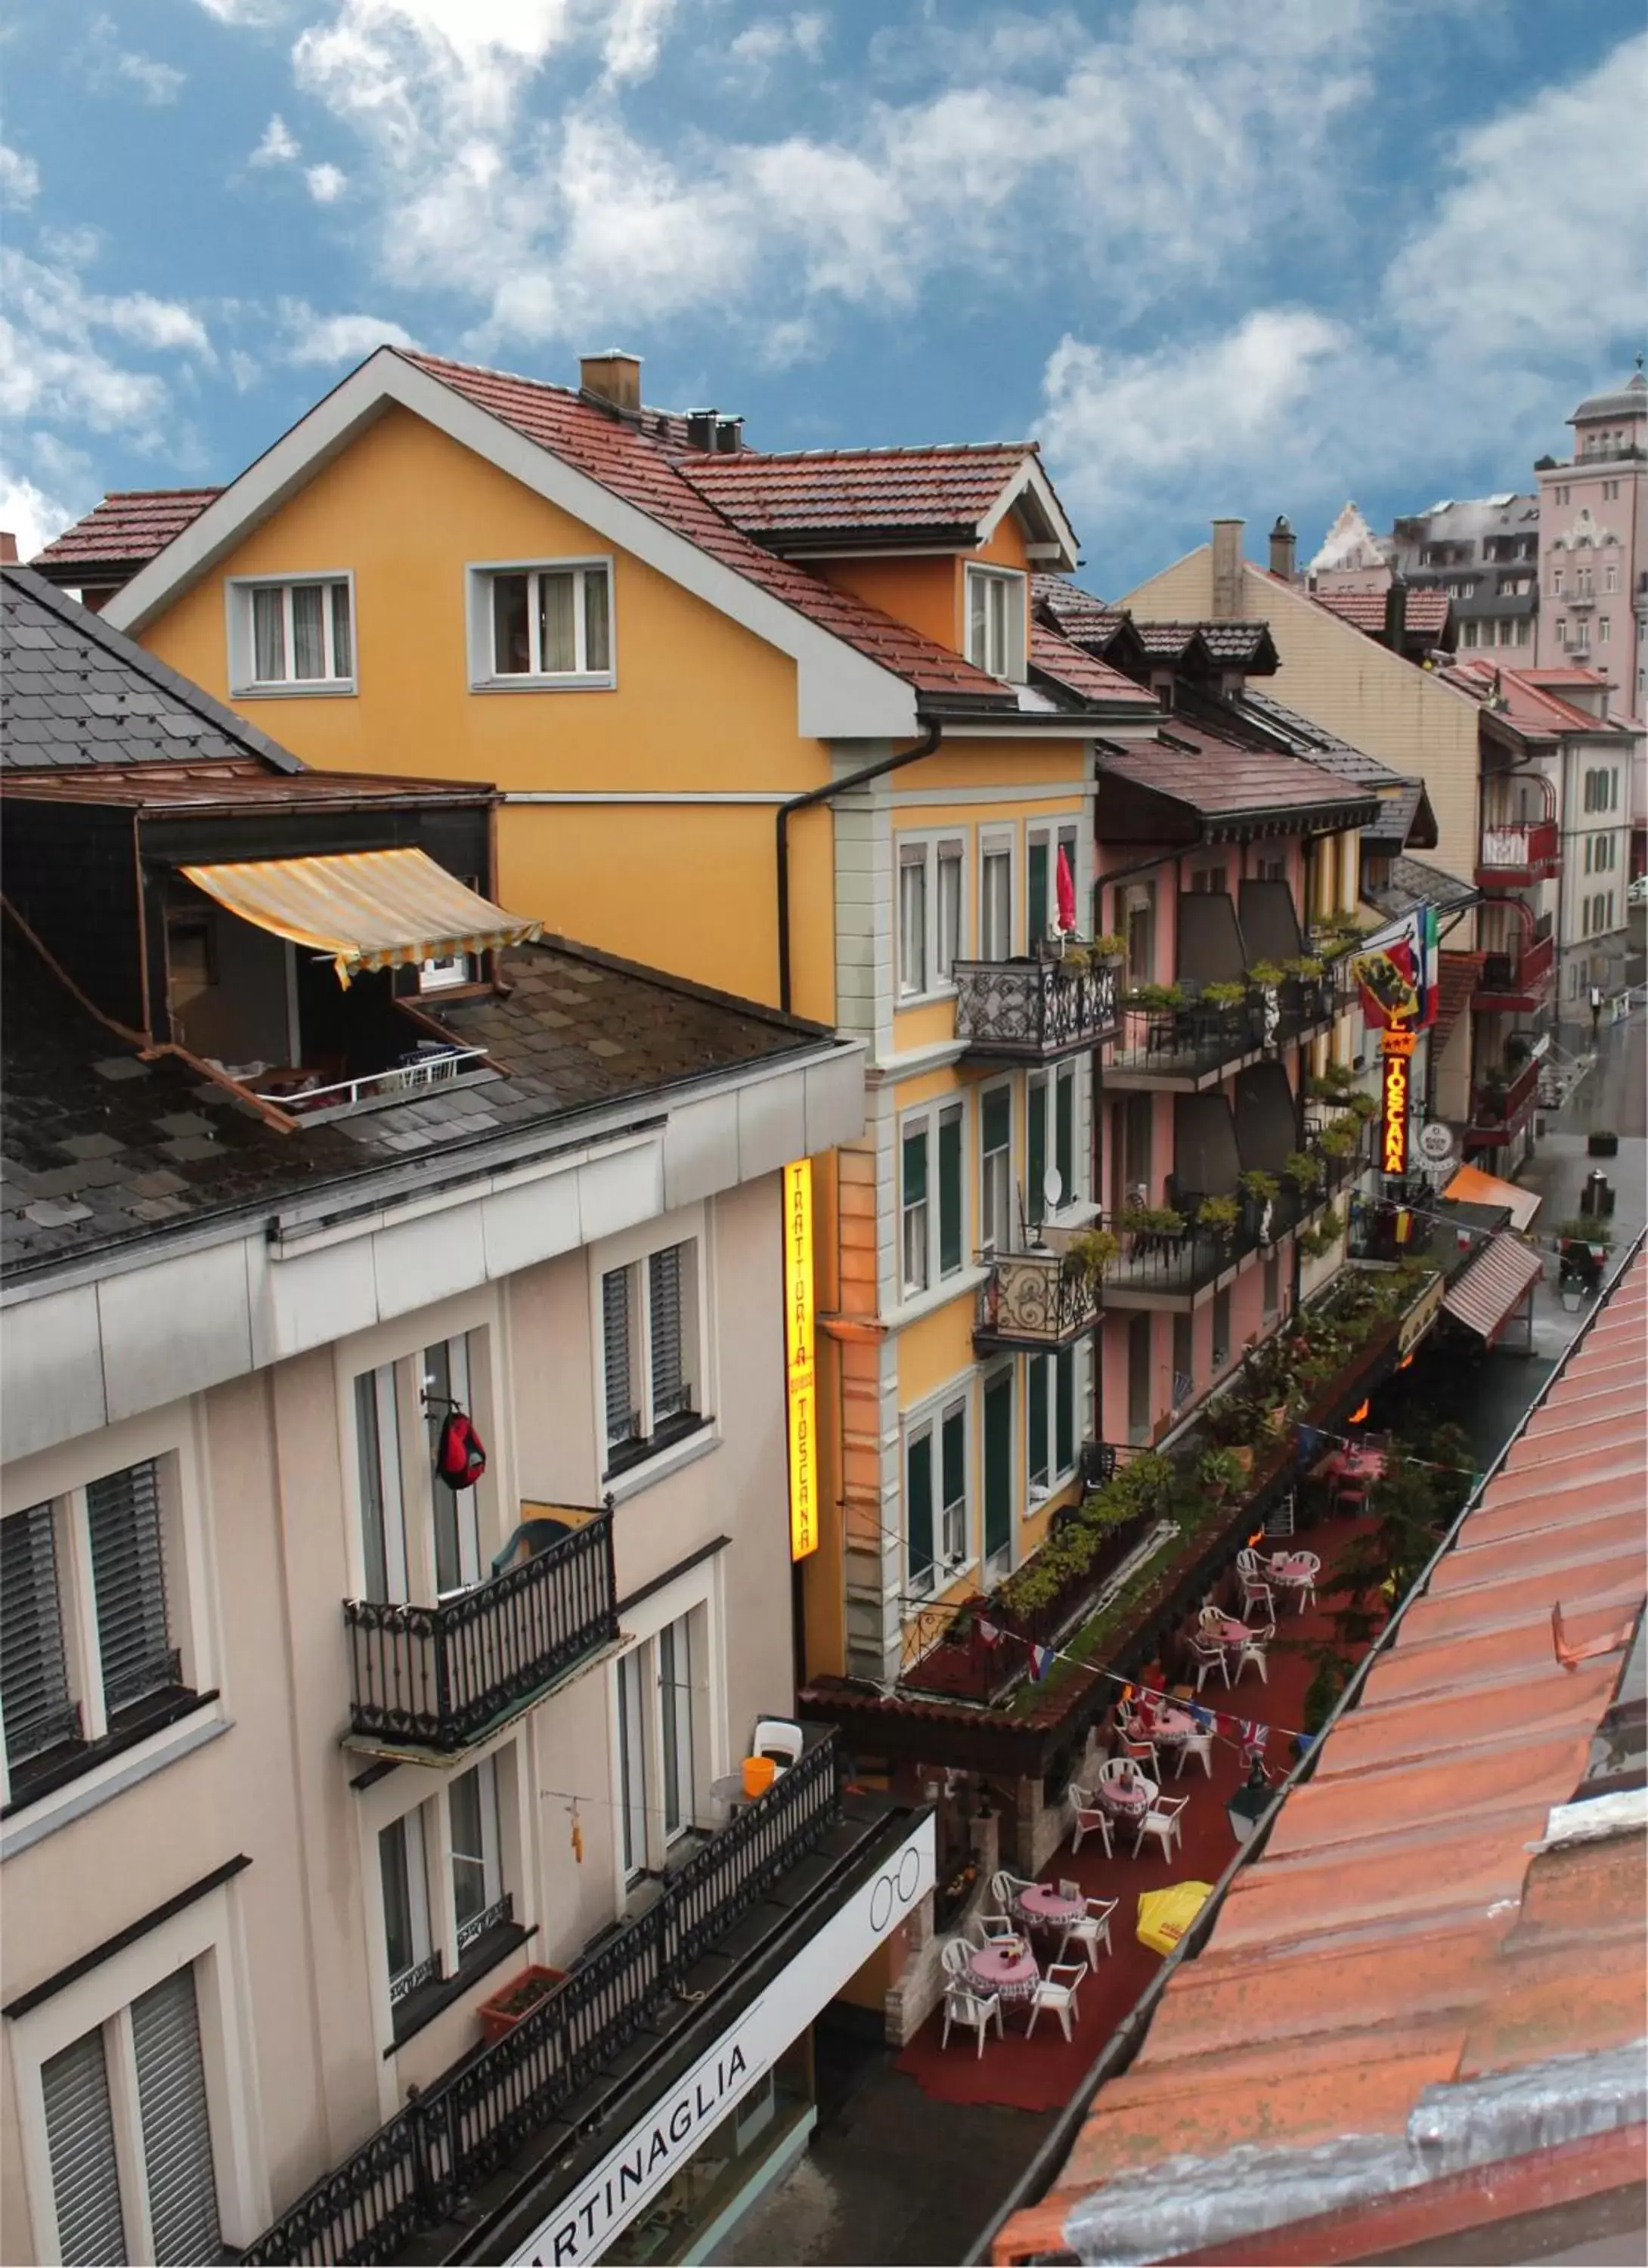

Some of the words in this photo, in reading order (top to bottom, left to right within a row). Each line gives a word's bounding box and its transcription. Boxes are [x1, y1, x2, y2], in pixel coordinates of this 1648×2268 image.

[1385, 1058, 1406, 1173] TOSCANA
[793, 1168, 806, 1368] TRATTORIA
[798, 1397, 810, 1550] TOSCANA
[531, 2043, 747, 2267] RTINAGLIA
